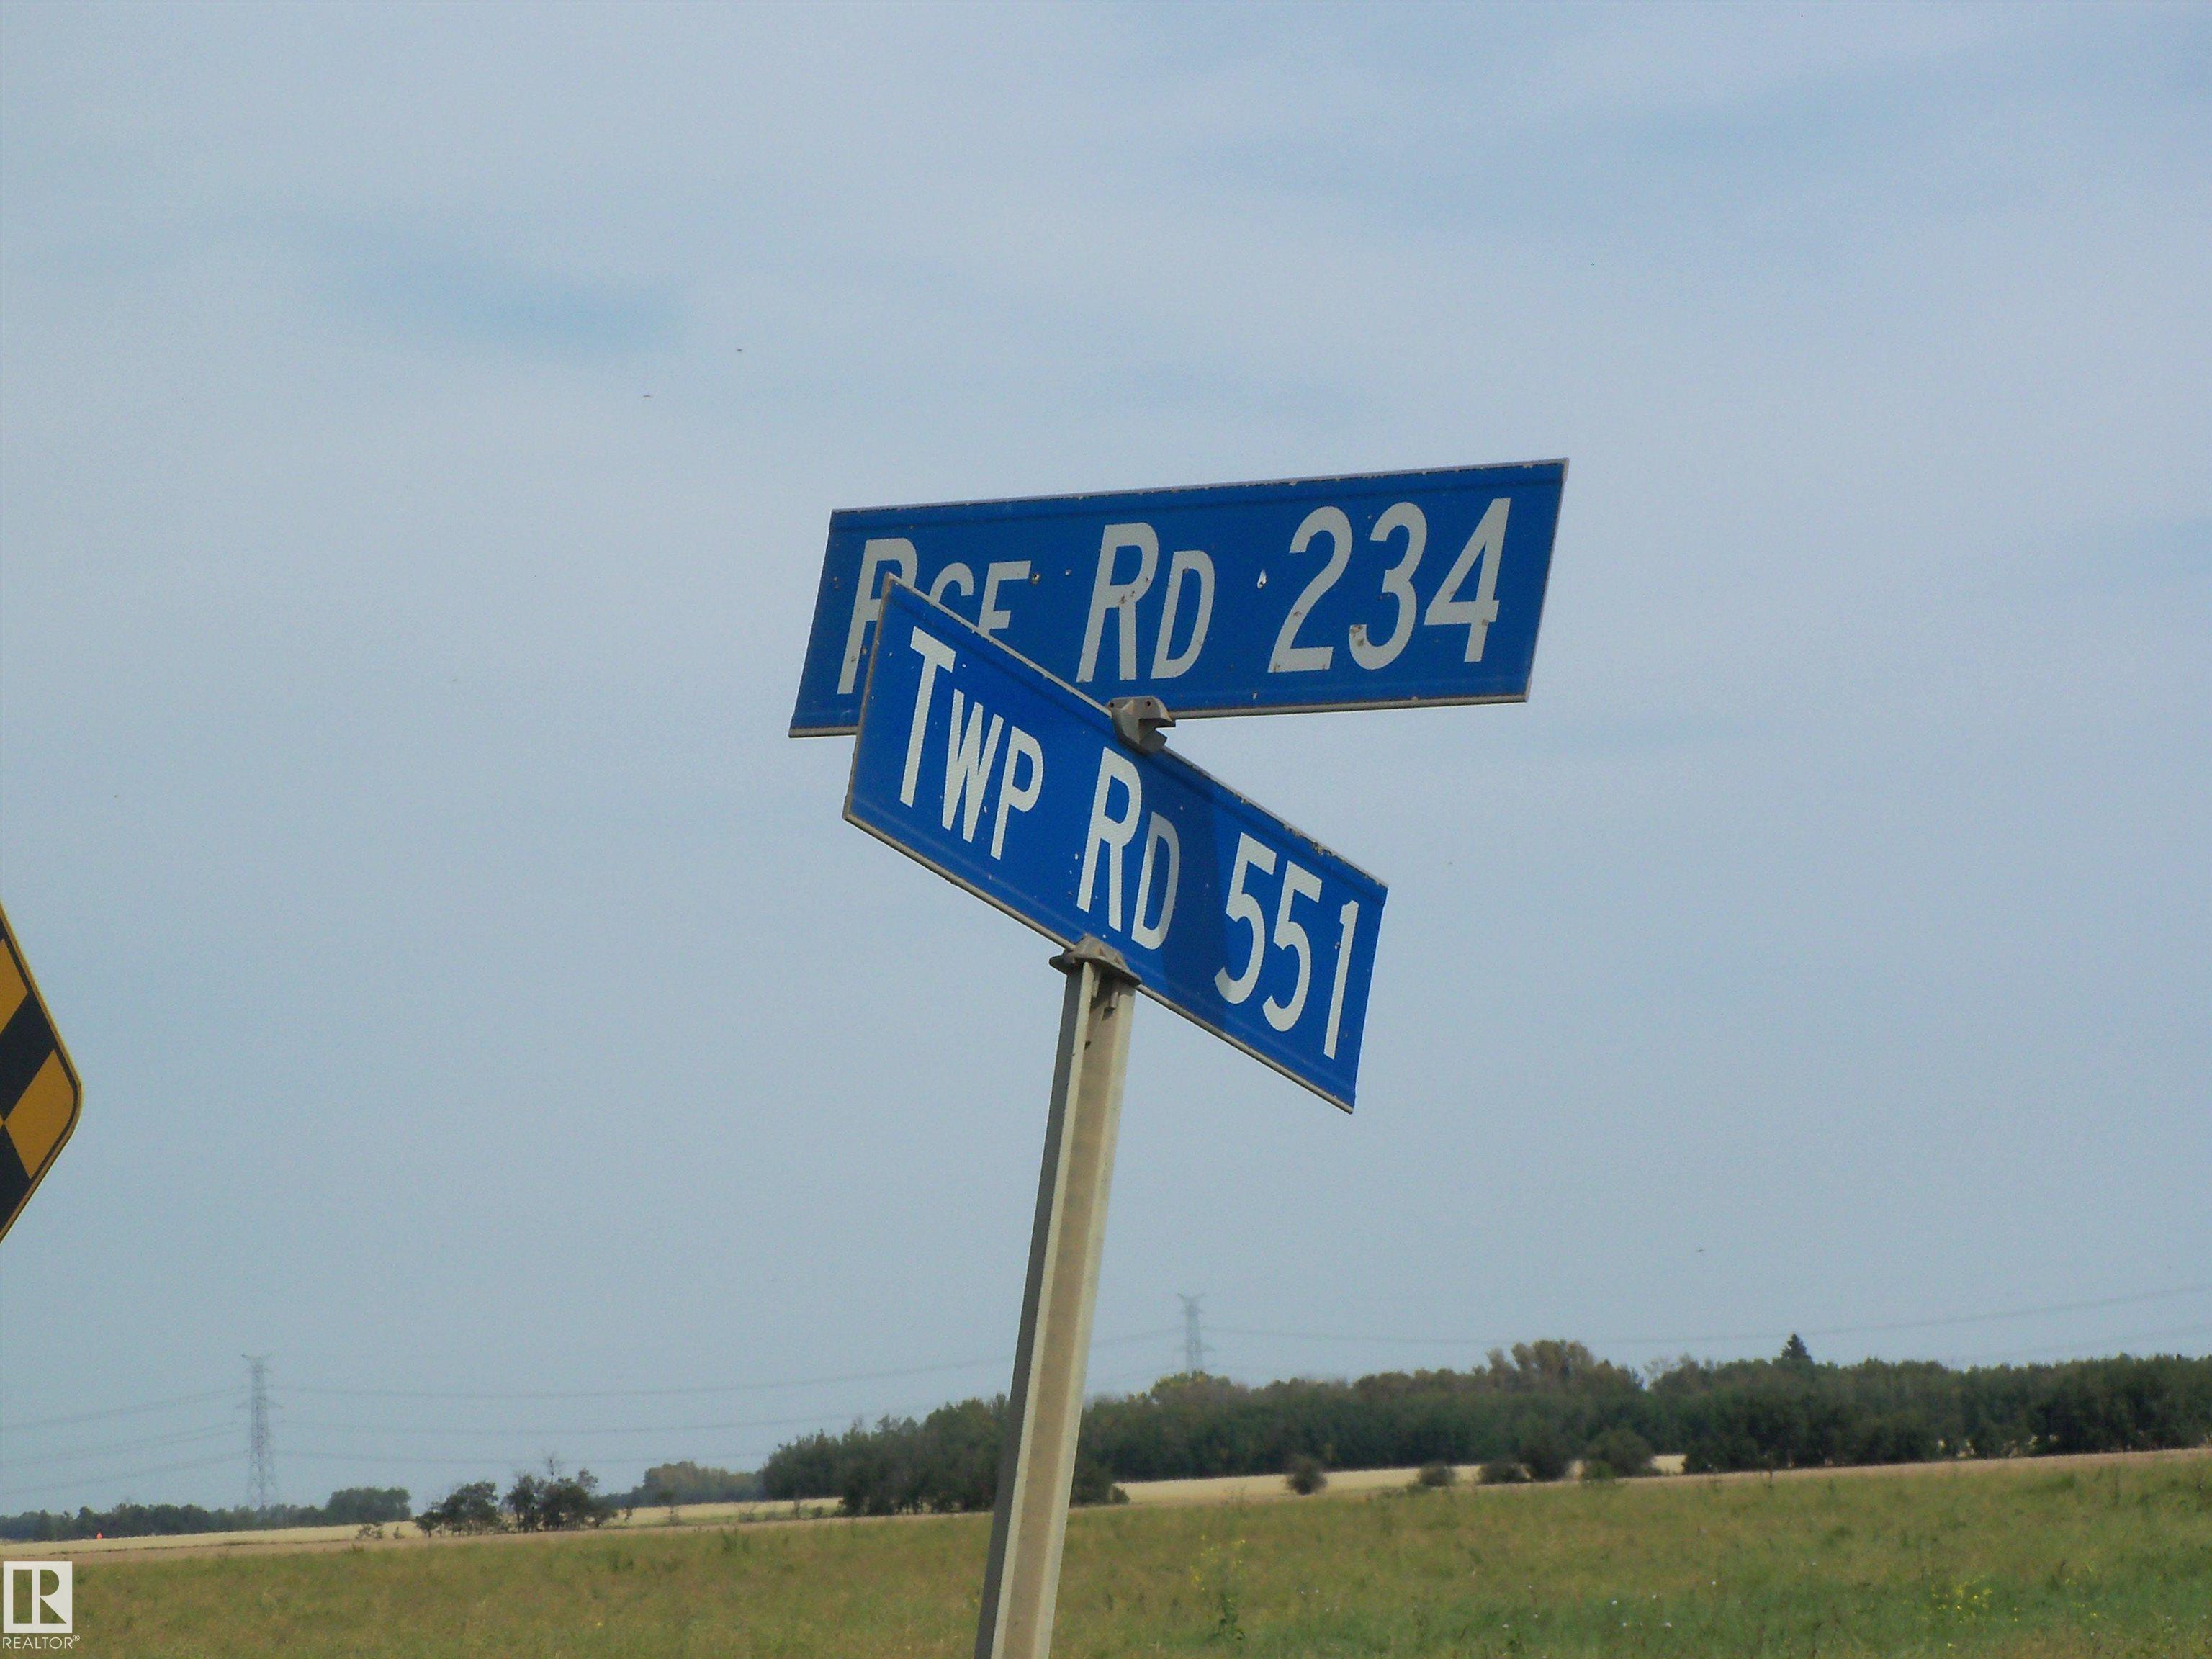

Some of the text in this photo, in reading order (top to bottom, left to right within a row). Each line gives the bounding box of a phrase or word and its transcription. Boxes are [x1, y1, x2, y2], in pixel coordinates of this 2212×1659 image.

[1076, 522, 1215, 683] RD
[1268, 498, 1511, 673] 234
[899, 626, 1359, 1060] TWP RD 551
